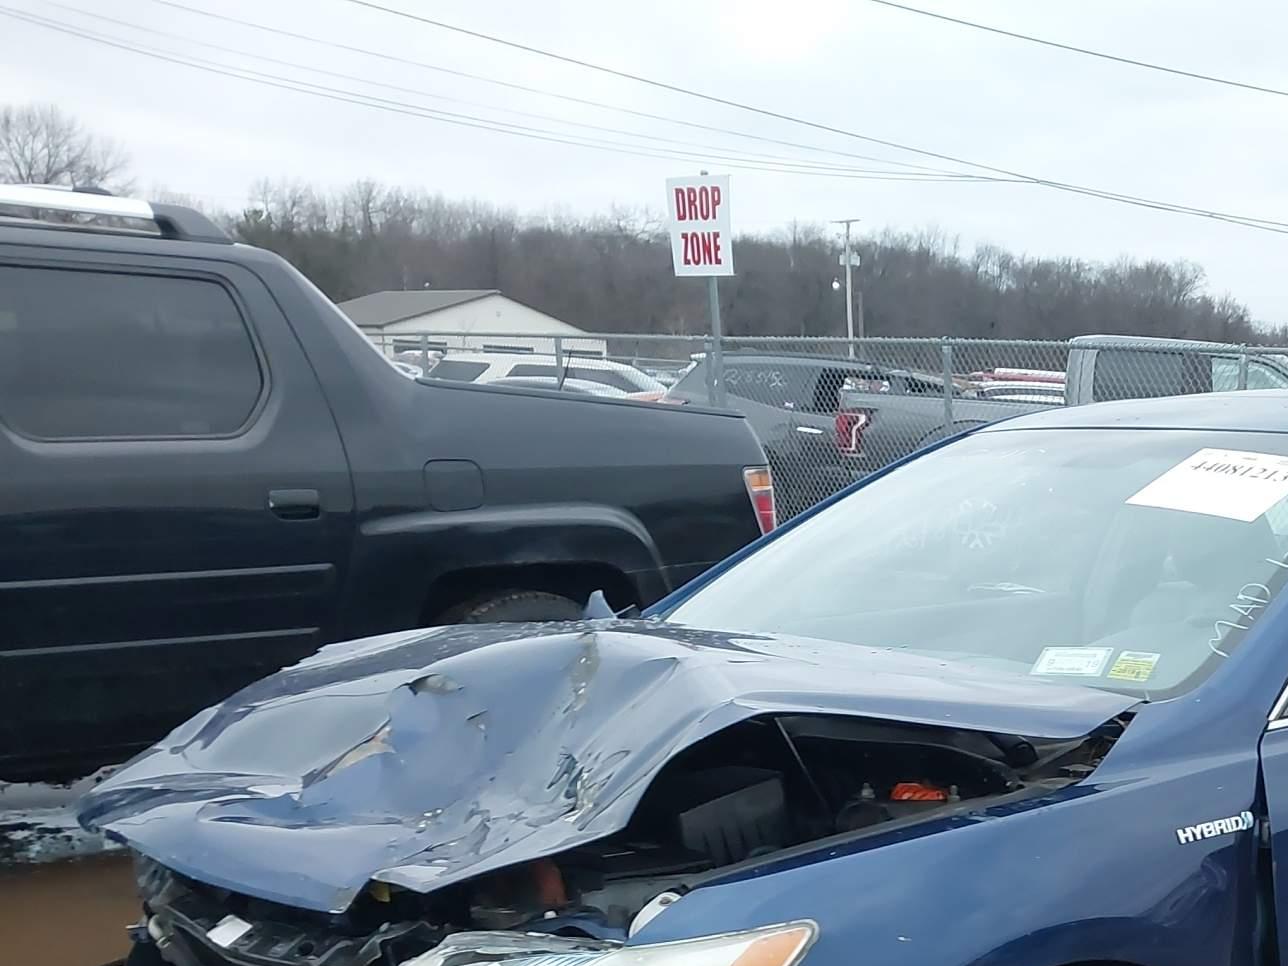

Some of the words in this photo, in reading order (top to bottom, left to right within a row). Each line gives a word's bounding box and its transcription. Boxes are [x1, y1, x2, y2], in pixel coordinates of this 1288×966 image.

[675, 186, 721, 221] DROP
[681, 232, 722, 265] ZONE
[1176, 815, 1245, 845] HYBRID
